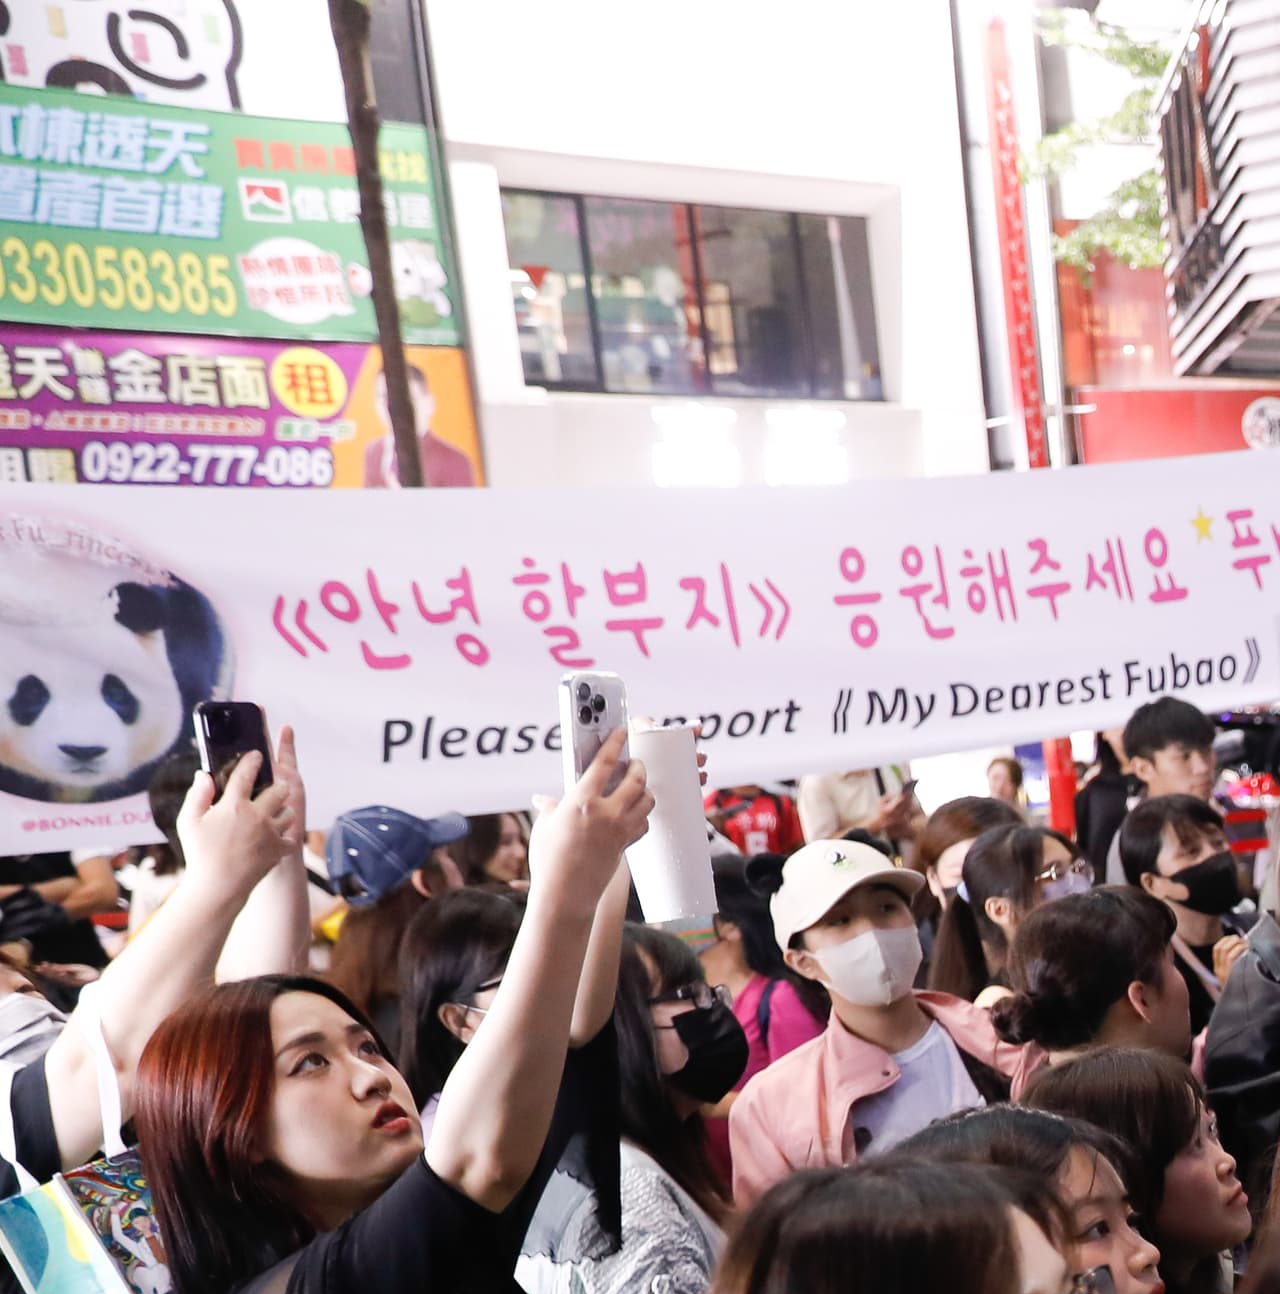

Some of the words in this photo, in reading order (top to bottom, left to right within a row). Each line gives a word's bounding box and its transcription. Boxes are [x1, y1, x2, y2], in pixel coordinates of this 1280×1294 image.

[0, 236, 238, 318] 33058385
[282, 361, 334, 405] 租
[83, 441, 333, 486] 0922-777-086
[833, 527, 1189, 649] 응원해주세요
[381, 716, 562, 763] Please
[950, 667, 1112, 718] Dearest
